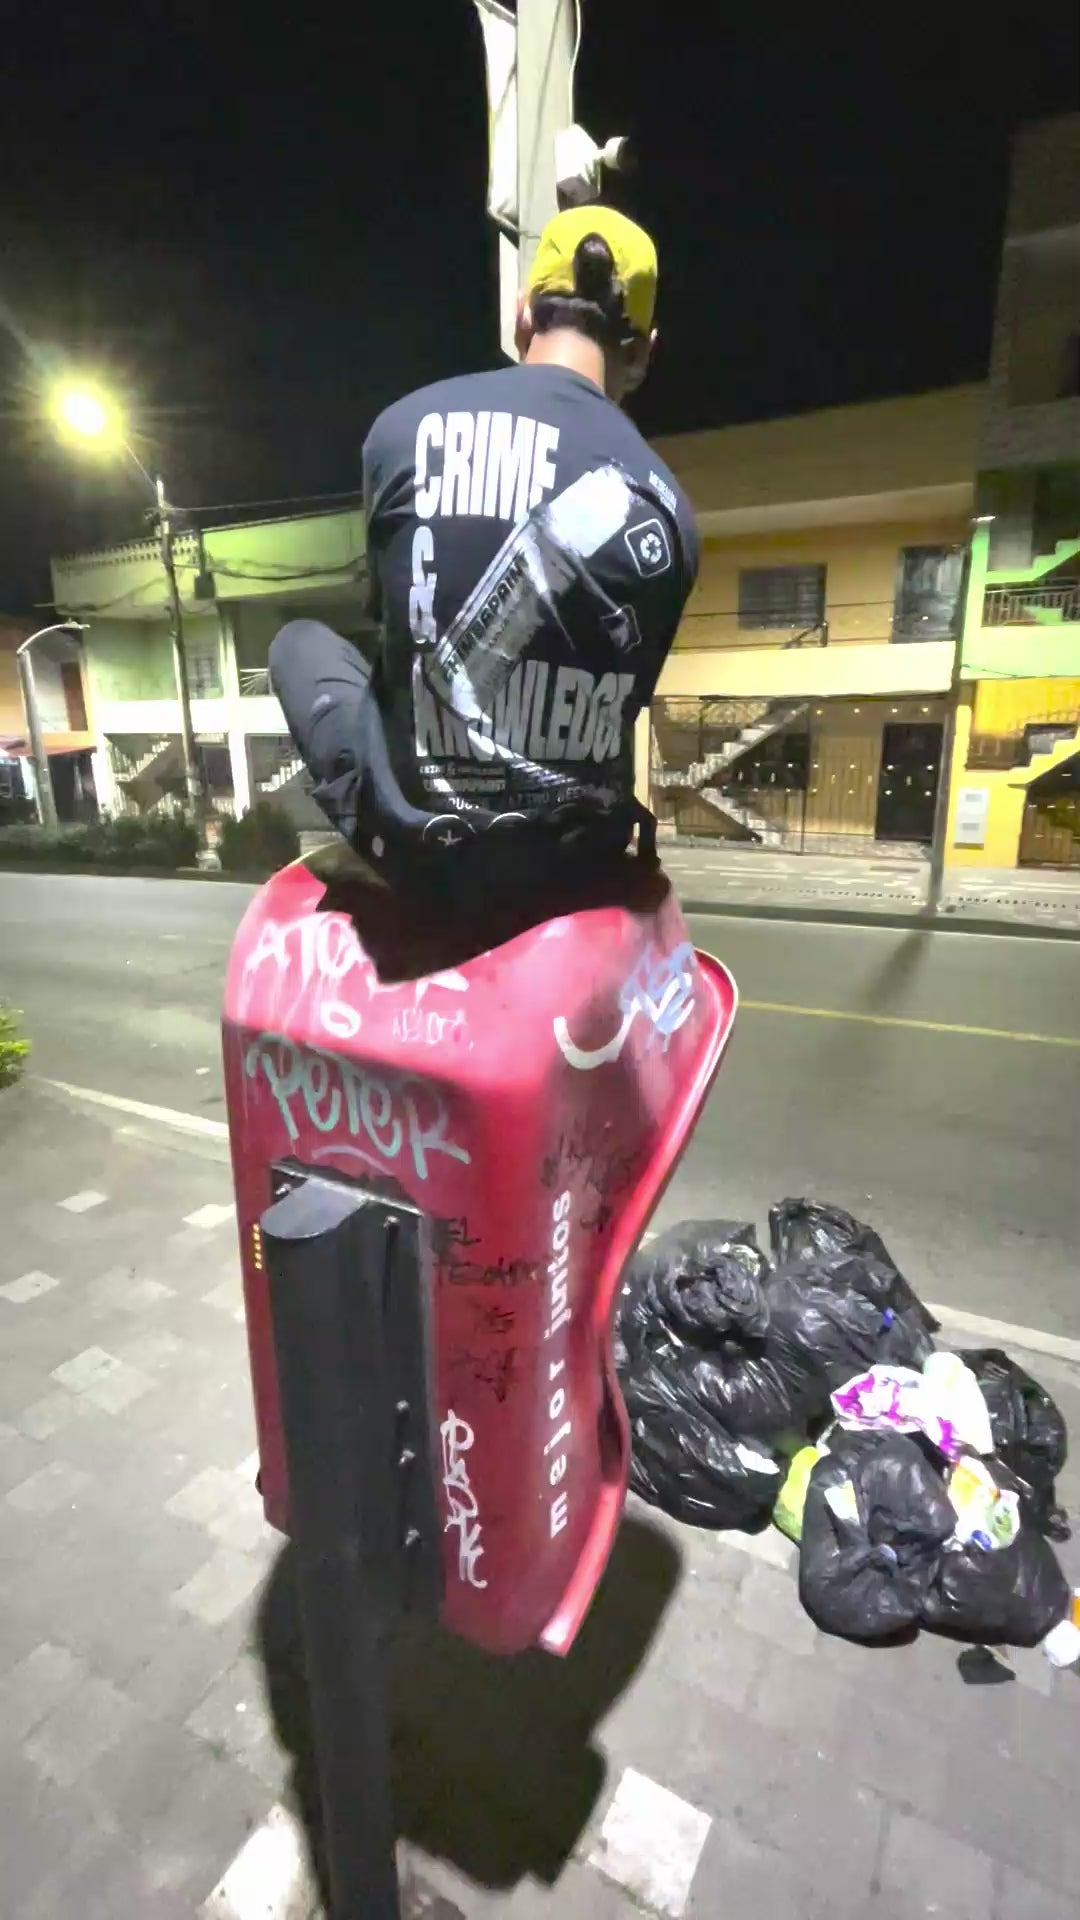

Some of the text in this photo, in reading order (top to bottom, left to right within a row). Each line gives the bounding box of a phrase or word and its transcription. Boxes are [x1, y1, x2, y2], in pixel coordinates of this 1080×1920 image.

[414, 411, 560, 524] CRIME
[544, 1190, 572, 1538] mejor juntos
